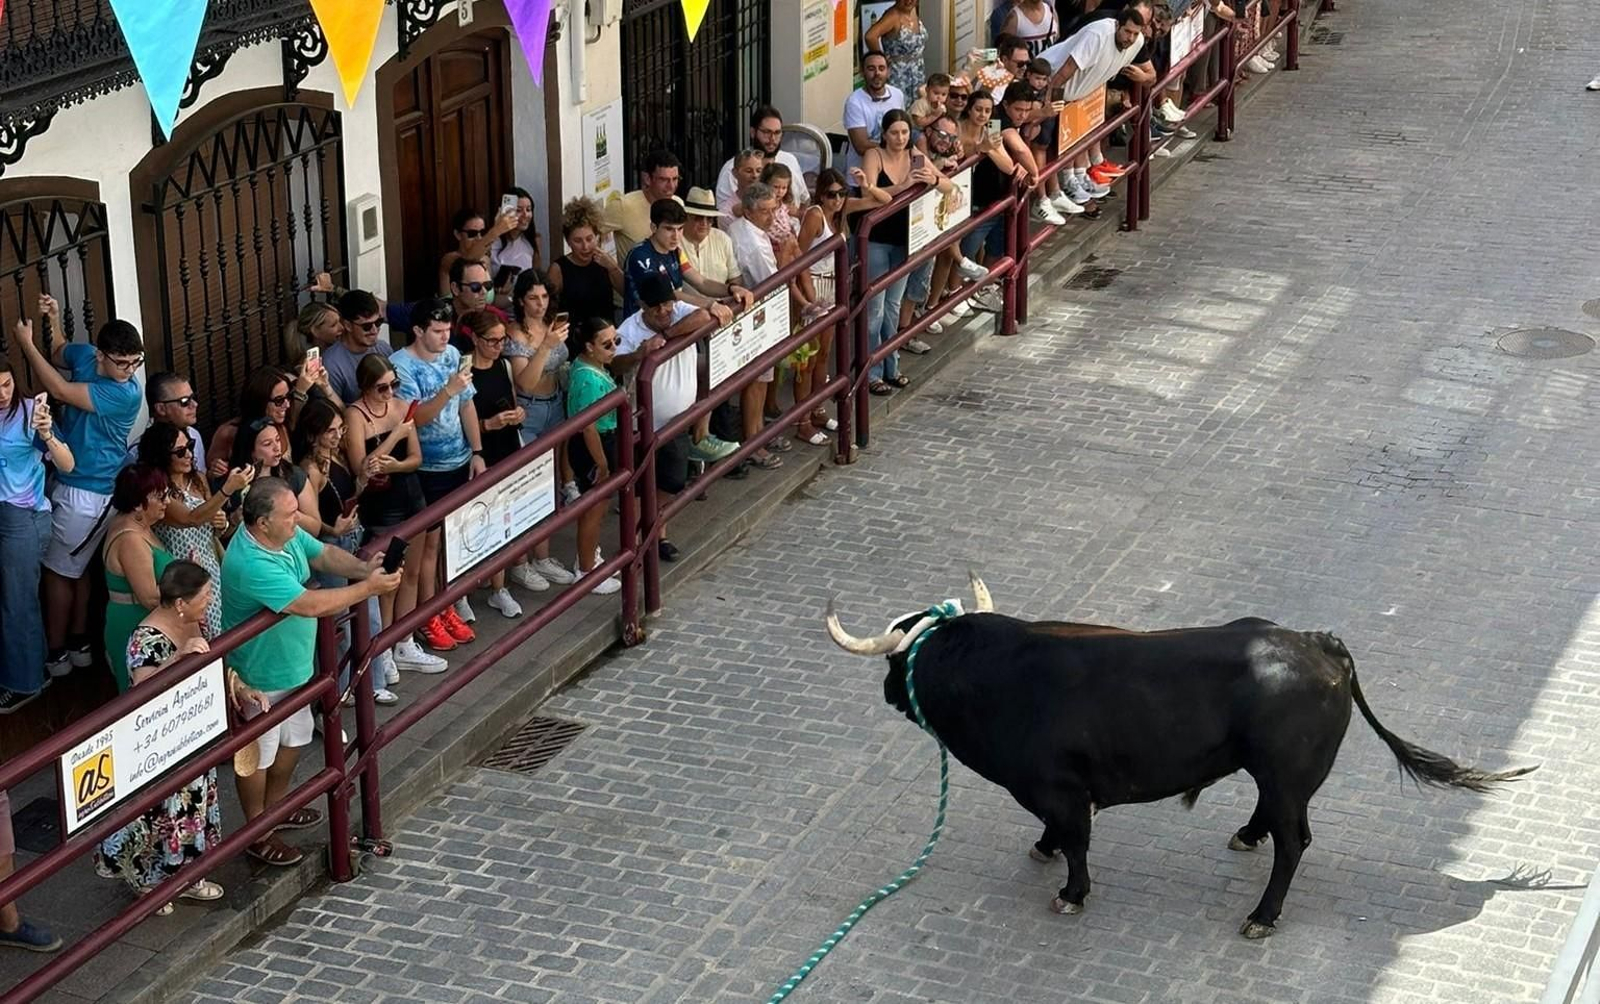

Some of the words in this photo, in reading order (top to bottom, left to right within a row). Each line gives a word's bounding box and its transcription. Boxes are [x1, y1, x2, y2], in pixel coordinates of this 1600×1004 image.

[133, 729, 159, 754] +34
[161, 692, 214, 738] 607981681
[134, 705, 168, 732] Servicios
[70, 743, 94, 765] Desde
[95, 729, 114, 747] 1995
